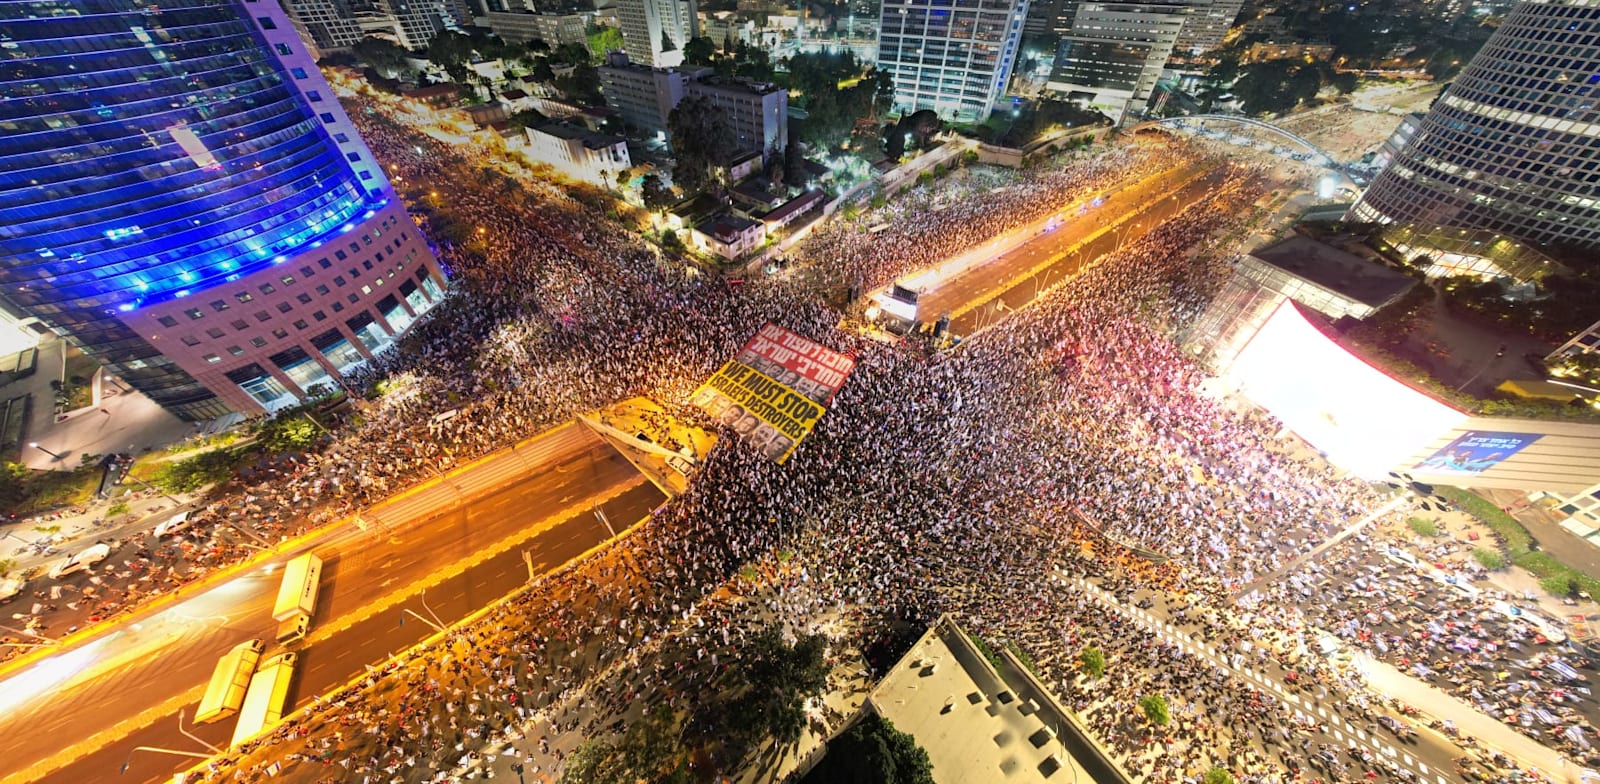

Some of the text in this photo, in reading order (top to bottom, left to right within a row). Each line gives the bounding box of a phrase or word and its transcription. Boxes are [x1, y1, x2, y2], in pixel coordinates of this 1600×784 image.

[751, 335, 844, 388] מחריבי ישראל
[760, 324, 854, 373] חובה לעצור את
[709, 375, 806, 440] ISRAEL'S DESTROYERS
[722, 361, 819, 424] WE MUST STOP
